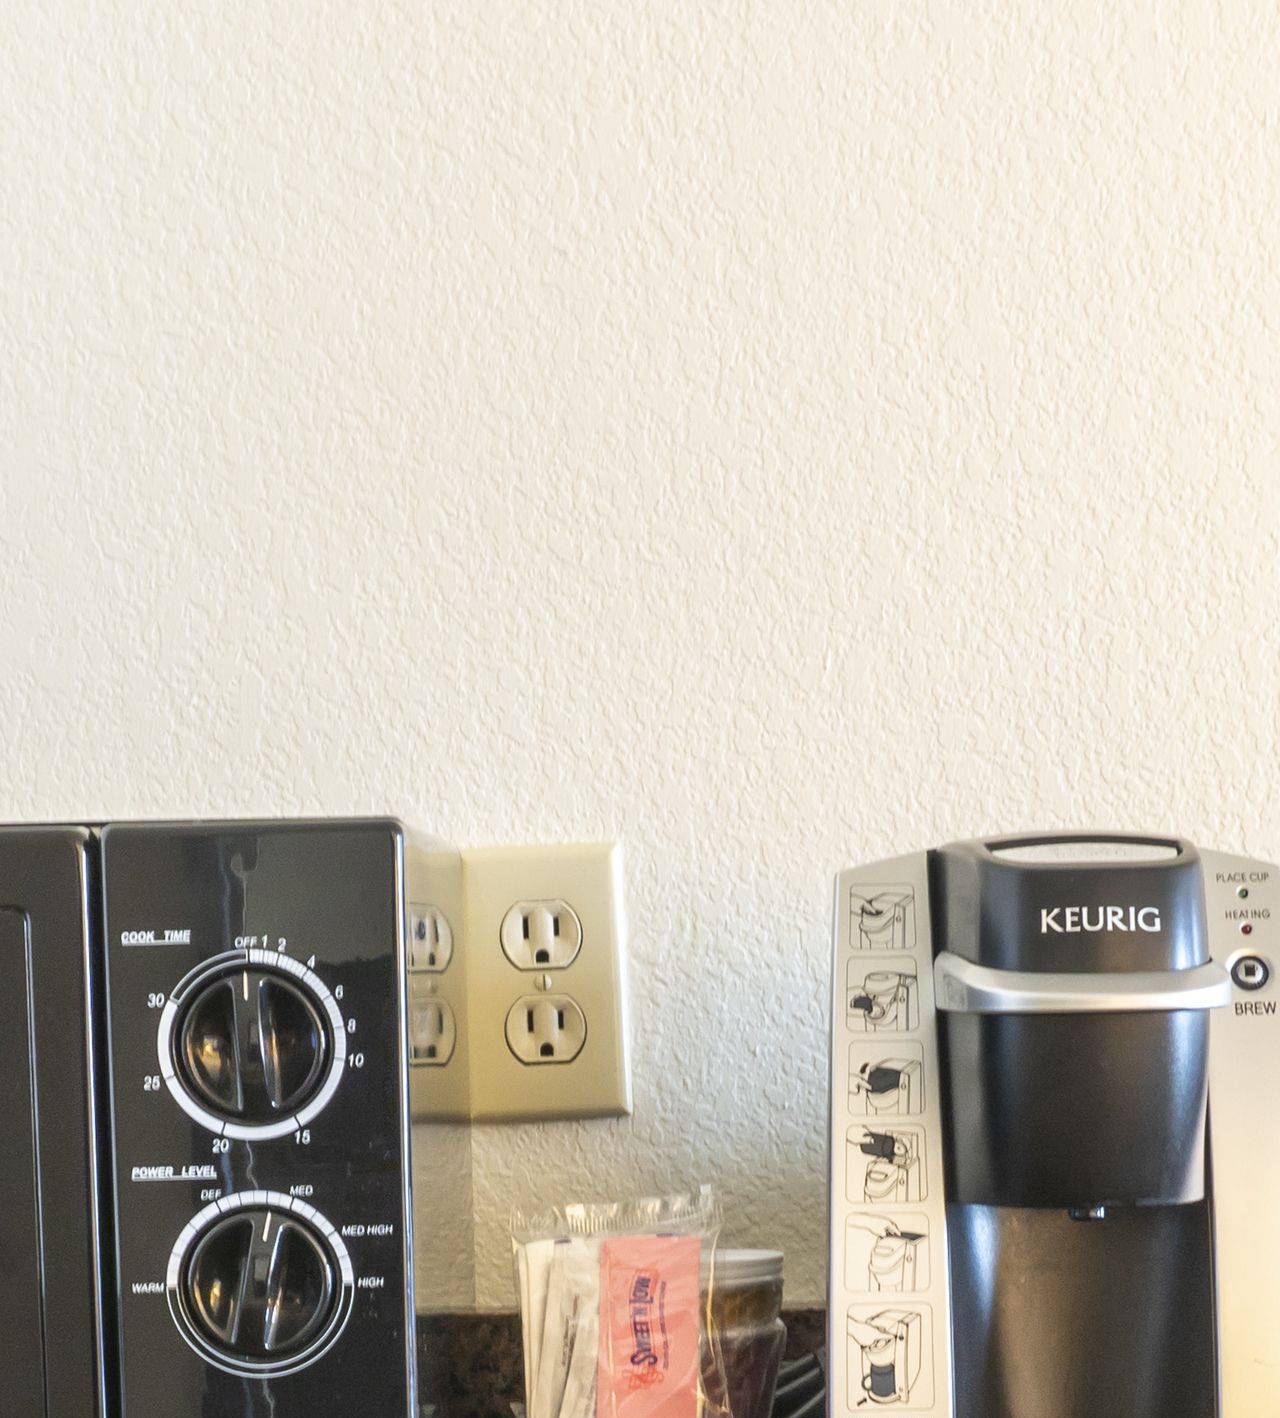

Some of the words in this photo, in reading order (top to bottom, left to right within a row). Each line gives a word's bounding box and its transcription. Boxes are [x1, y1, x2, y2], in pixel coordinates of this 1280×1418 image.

[1216, 872, 1247, 883] PLACE
[1249, 872, 1270, 882] CUP
[1041, 906, 1161, 934] KEURIG
[1225, 909, 1270, 919] HEATING
[121, 930, 155, 944] COOK
[164, 929, 191, 943] TIME
[235, 937, 257, 948] OFF
[261, 935, 268, 948] 1
[277, 938, 287, 951] 2
[307, 955, 316, 969] 4
[335, 985, 344, 999] 6
[147, 993, 165, 1008] 30
[1235, 1002, 1277, 1016] BREW
[347, 1019, 356, 1033] 8
[348, 1053, 365, 1067] 10
[144, 1076, 161, 1091] 25
[295, 1130, 311, 1144] 15
[212, 1138, 230, 1153] 20
[132, 1166, 174, 1180] POWER
[181, 1165, 217, 1179] LEVEL
[289, 1185, 314, 1196] MED
[341, 1224, 365, 1237] MED
[367, 1224, 394, 1236] HIGH
[132, 1283, 165, 1294] WARM
[358, 1276, 385, 1288] HIGH
